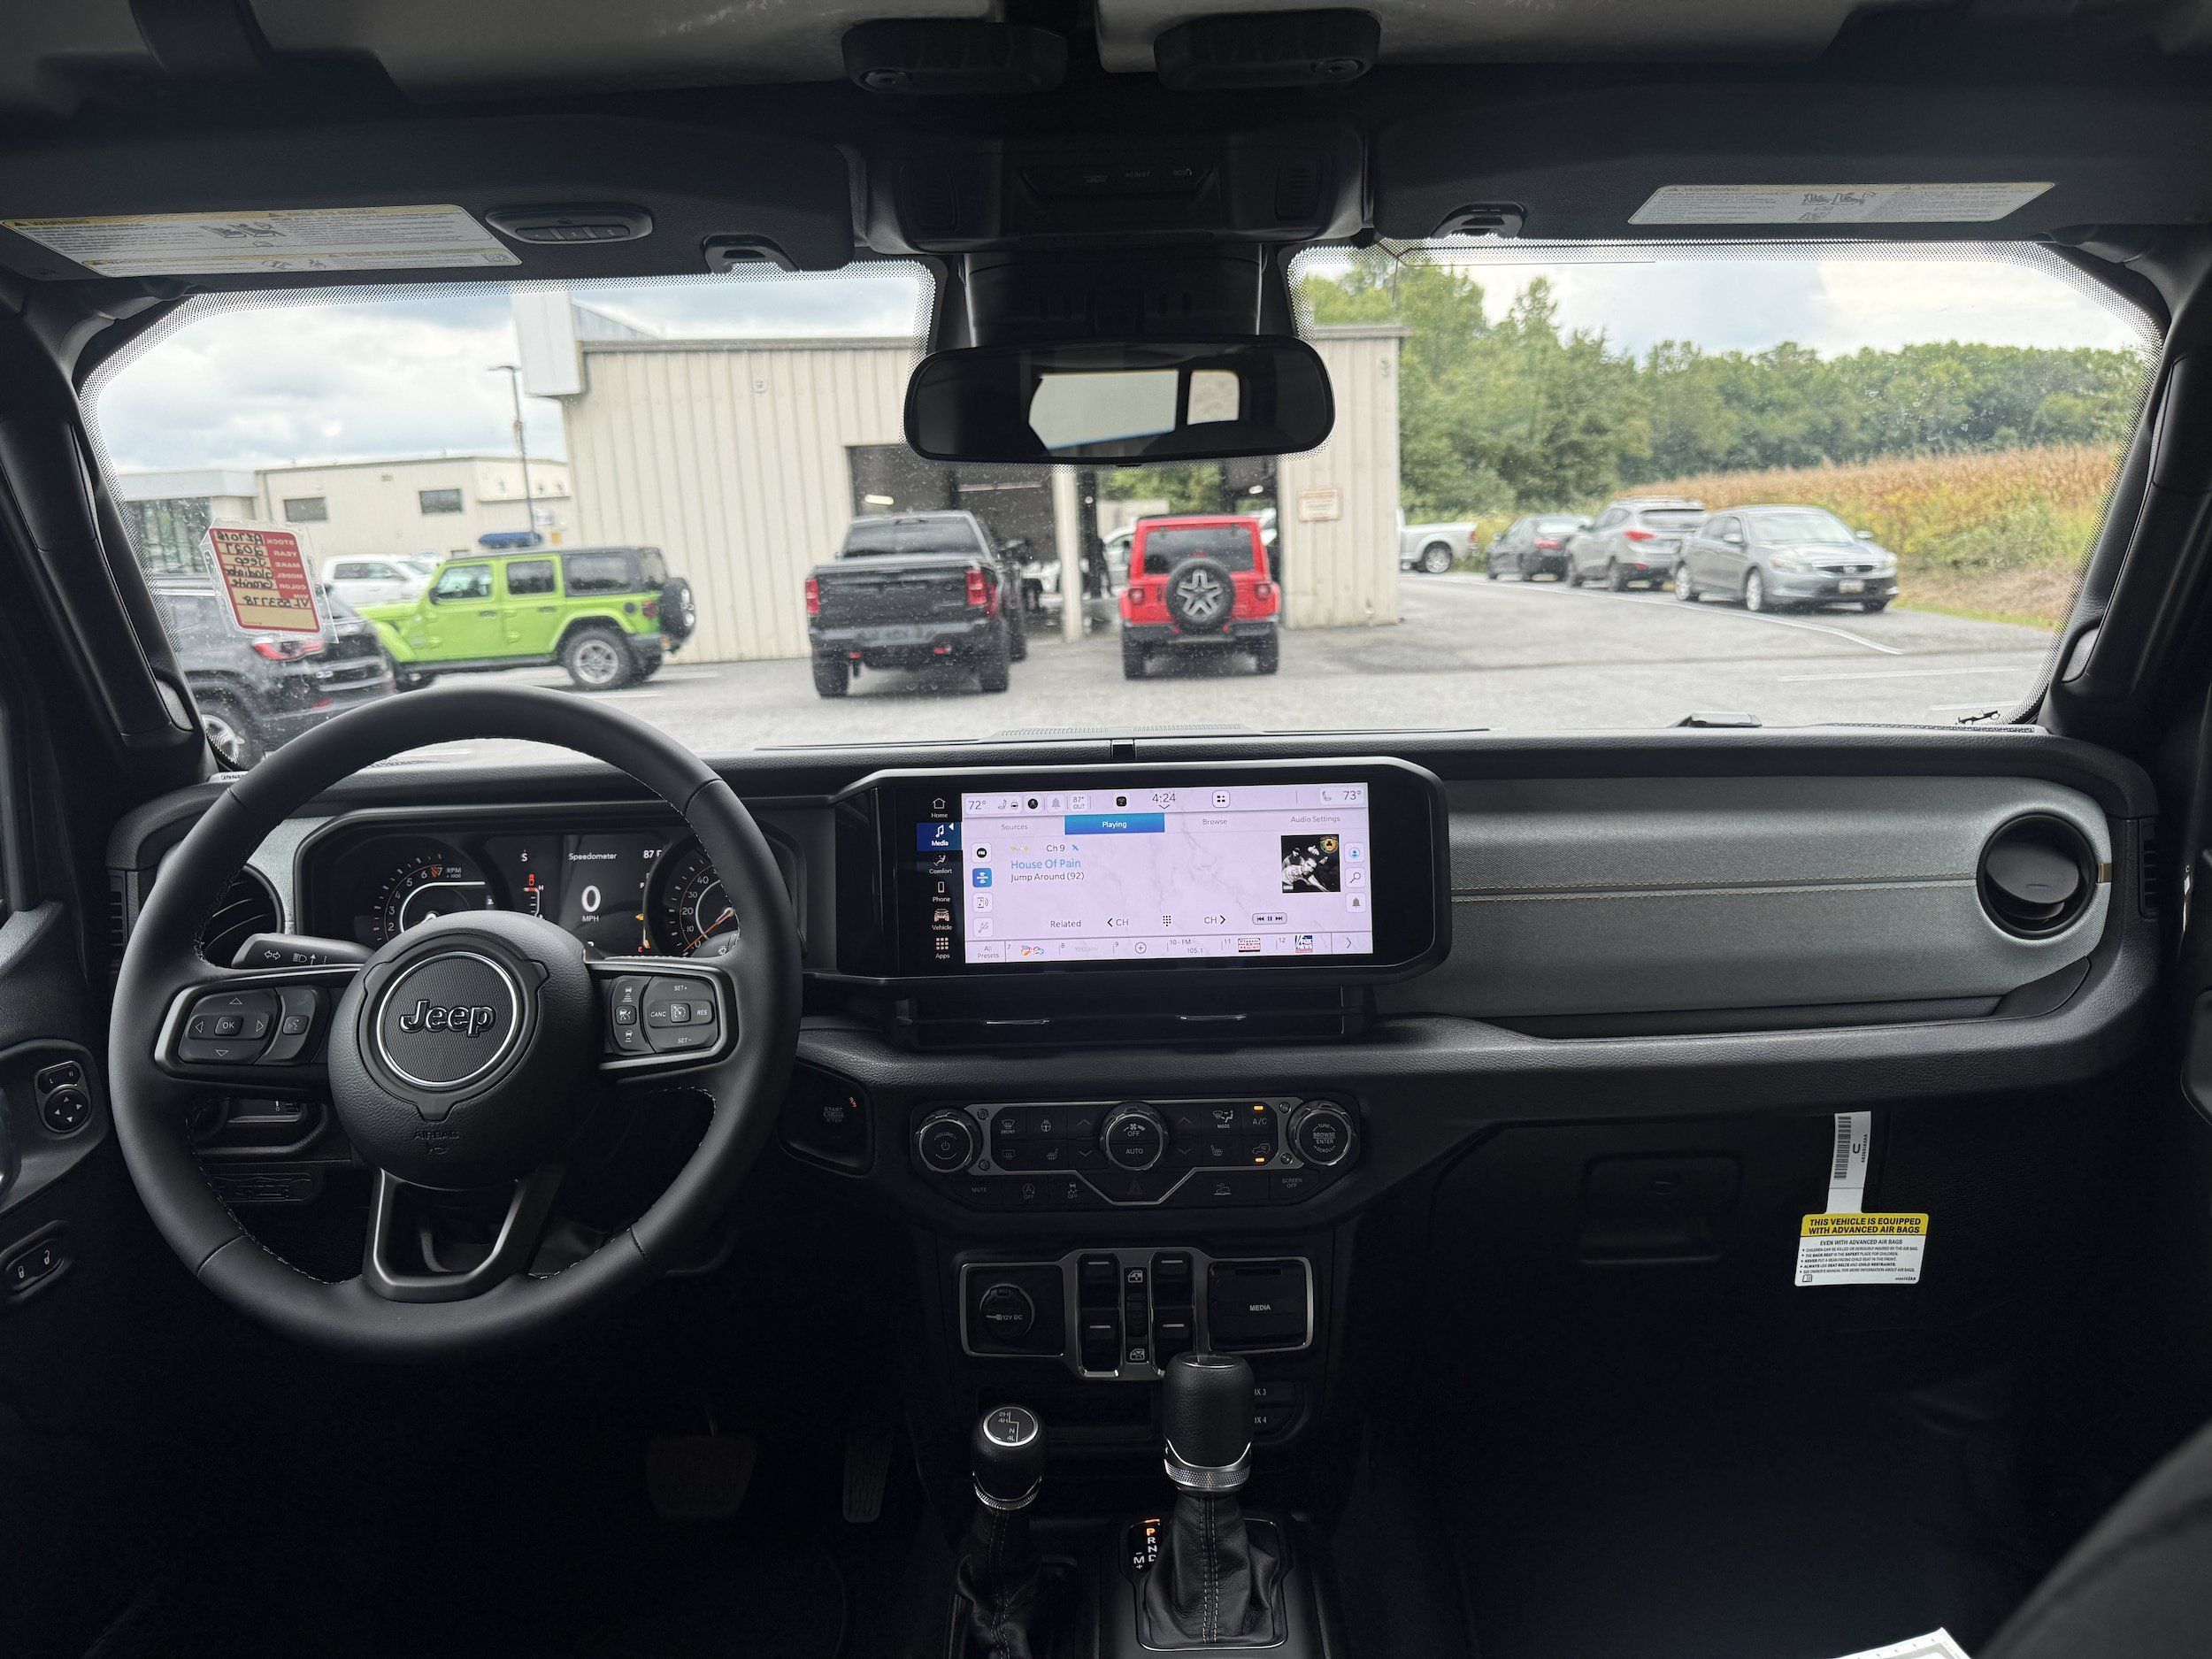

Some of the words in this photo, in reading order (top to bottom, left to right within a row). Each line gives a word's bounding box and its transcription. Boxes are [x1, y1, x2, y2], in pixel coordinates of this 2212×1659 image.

[1152, 793, 1177, 803] 4:24
[1343, 790, 1362, 801] 73°
[968, 800, 987, 810] 72°
[1312, 815, 1340, 824] Settings
[521, 853, 528, 862] S
[568, 852, 618, 861] Speedometer
[642, 850, 655, 859] 87
[1010, 860, 1043, 869] House
[1045, 859, 1057, 868] Of
[1059, 858, 1081, 868] Pain
[420, 870, 427, 879] 6
[437, 867, 443, 876] 7
[1010, 874, 1032, 883] Jump
[1033, 872, 1065, 881] Around
[1066, 872, 1085, 881] (92)
[407, 878, 413, 887] 5
[395, 890, 401, 899] 4
[581, 885, 602, 912] 0
[389, 906, 396, 915] 3
[681, 907, 694, 916] 20
[388, 922, 395, 931] 2
[400, 999, 497, 1038] Jeep
[1262, 1387, 1267, 1396] 3
[1146, 1527, 1156, 1536] P
[1148, 1545, 1158, 1554] N
[1133, 1555, 1145, 1564] M
